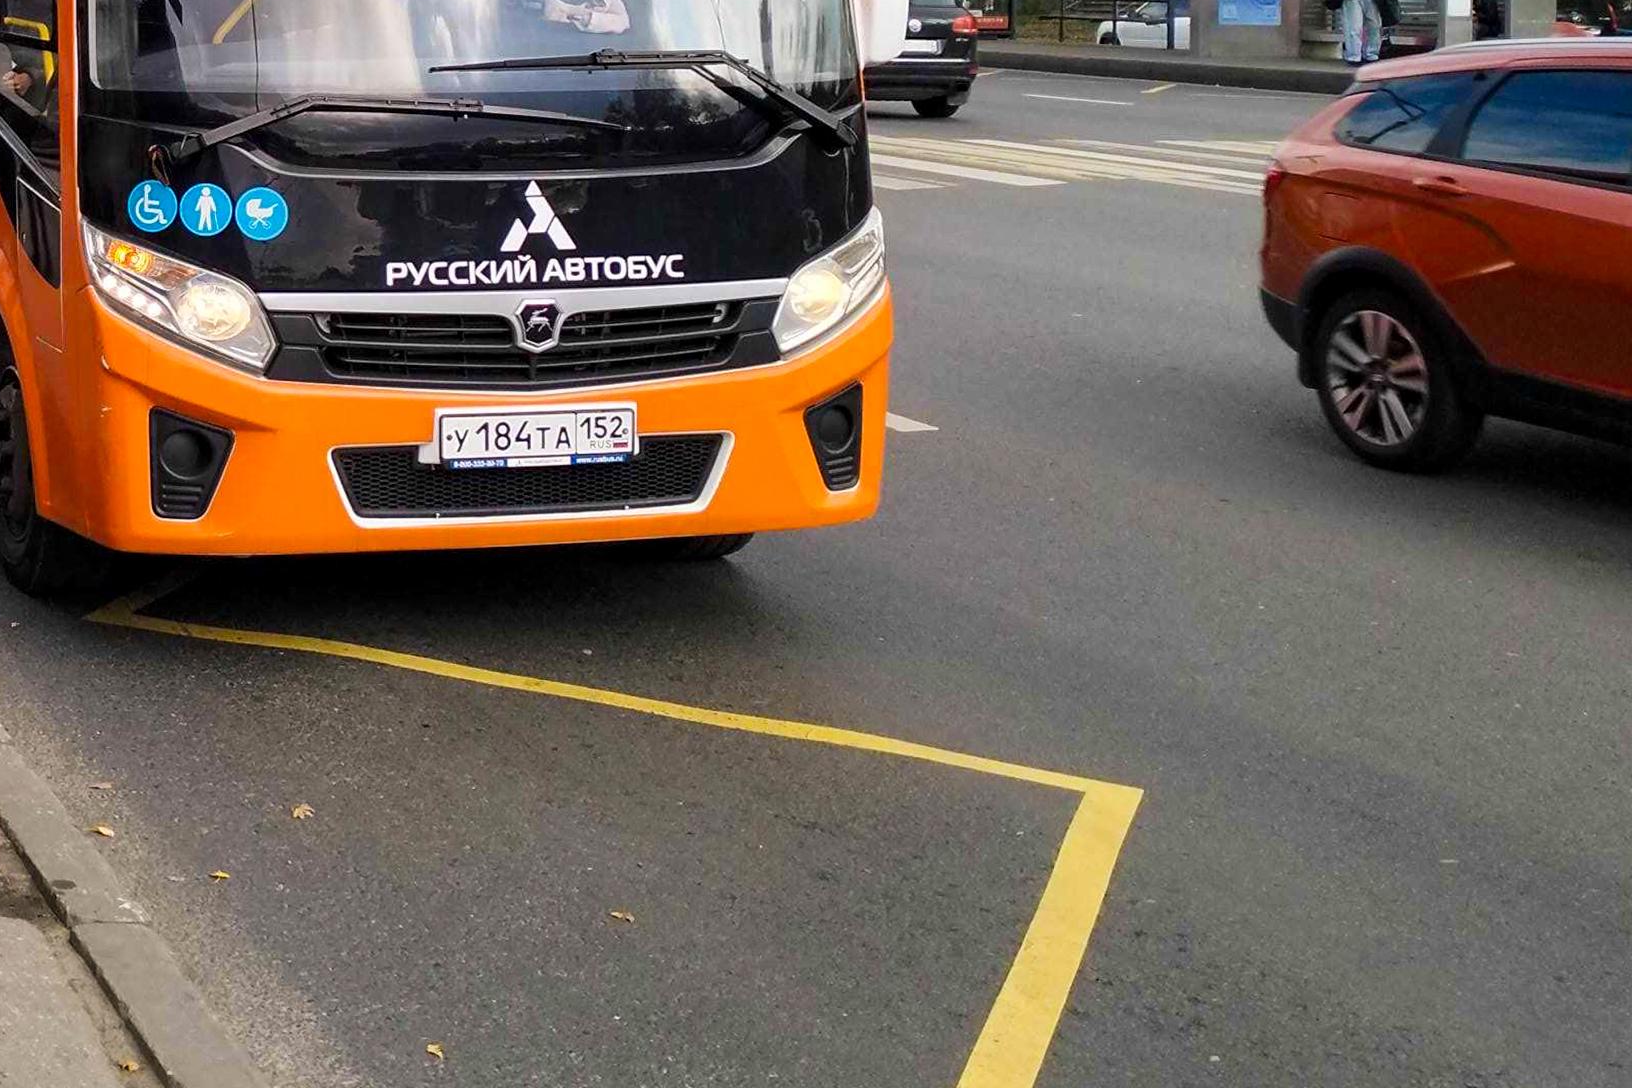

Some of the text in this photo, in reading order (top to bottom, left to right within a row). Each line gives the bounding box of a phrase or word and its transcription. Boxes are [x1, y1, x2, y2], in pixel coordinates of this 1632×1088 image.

[386, 254, 685, 287] РУССКИЙ АВТОБУС
[580, 416, 624, 439] 152
[590, 439, 612, 449] RUS
